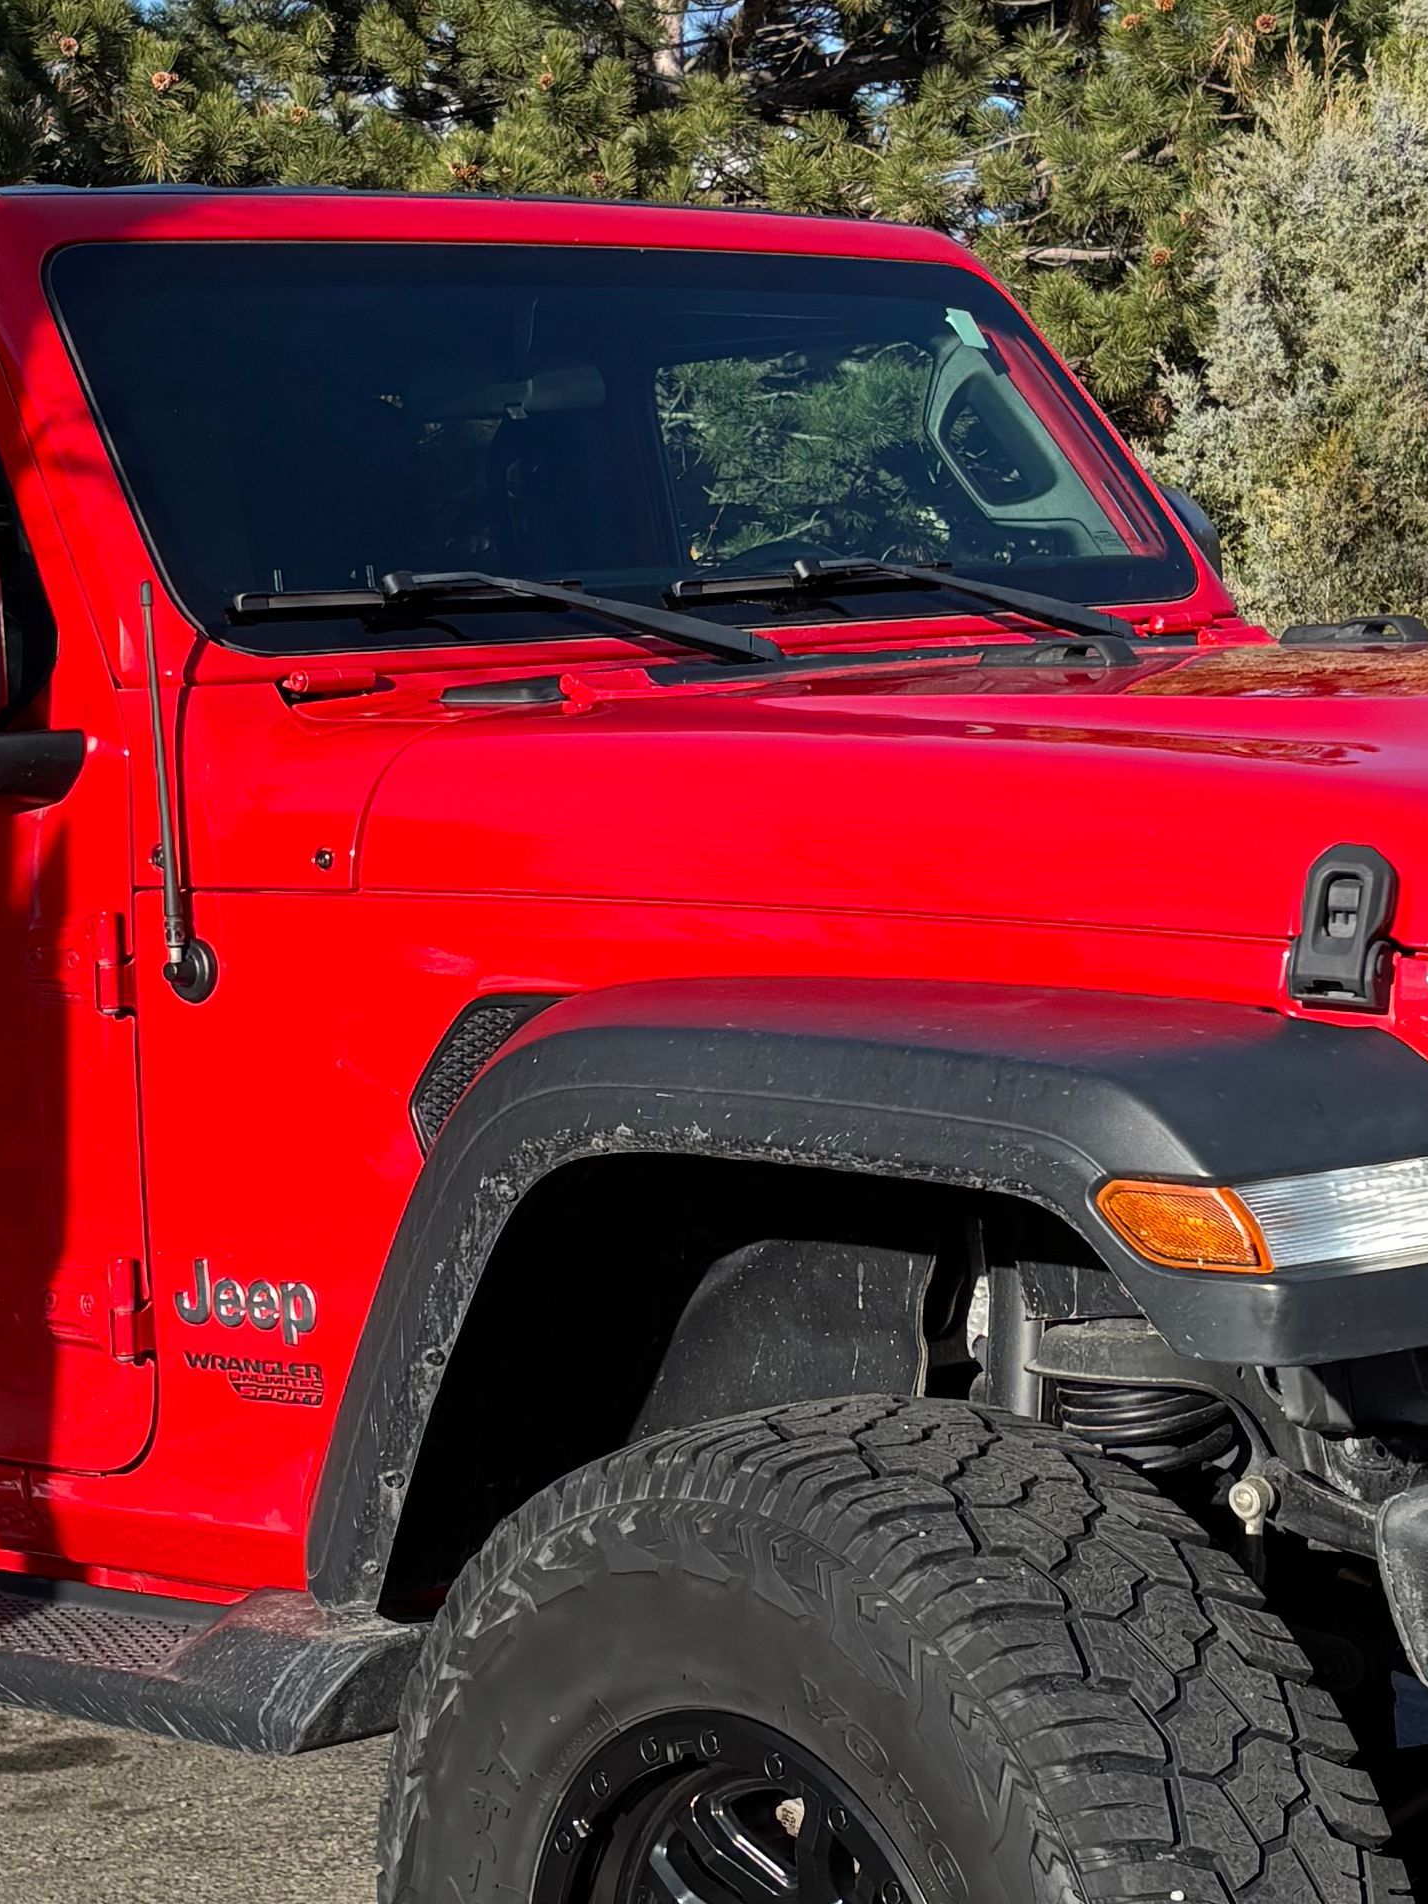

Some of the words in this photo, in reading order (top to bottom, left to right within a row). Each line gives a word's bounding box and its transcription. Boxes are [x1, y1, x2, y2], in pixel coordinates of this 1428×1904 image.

[174, 1258, 317, 1346] Jeep
[183, 1349, 322, 1380] WRANGLER
[240, 1385, 323, 1403] SPORT
